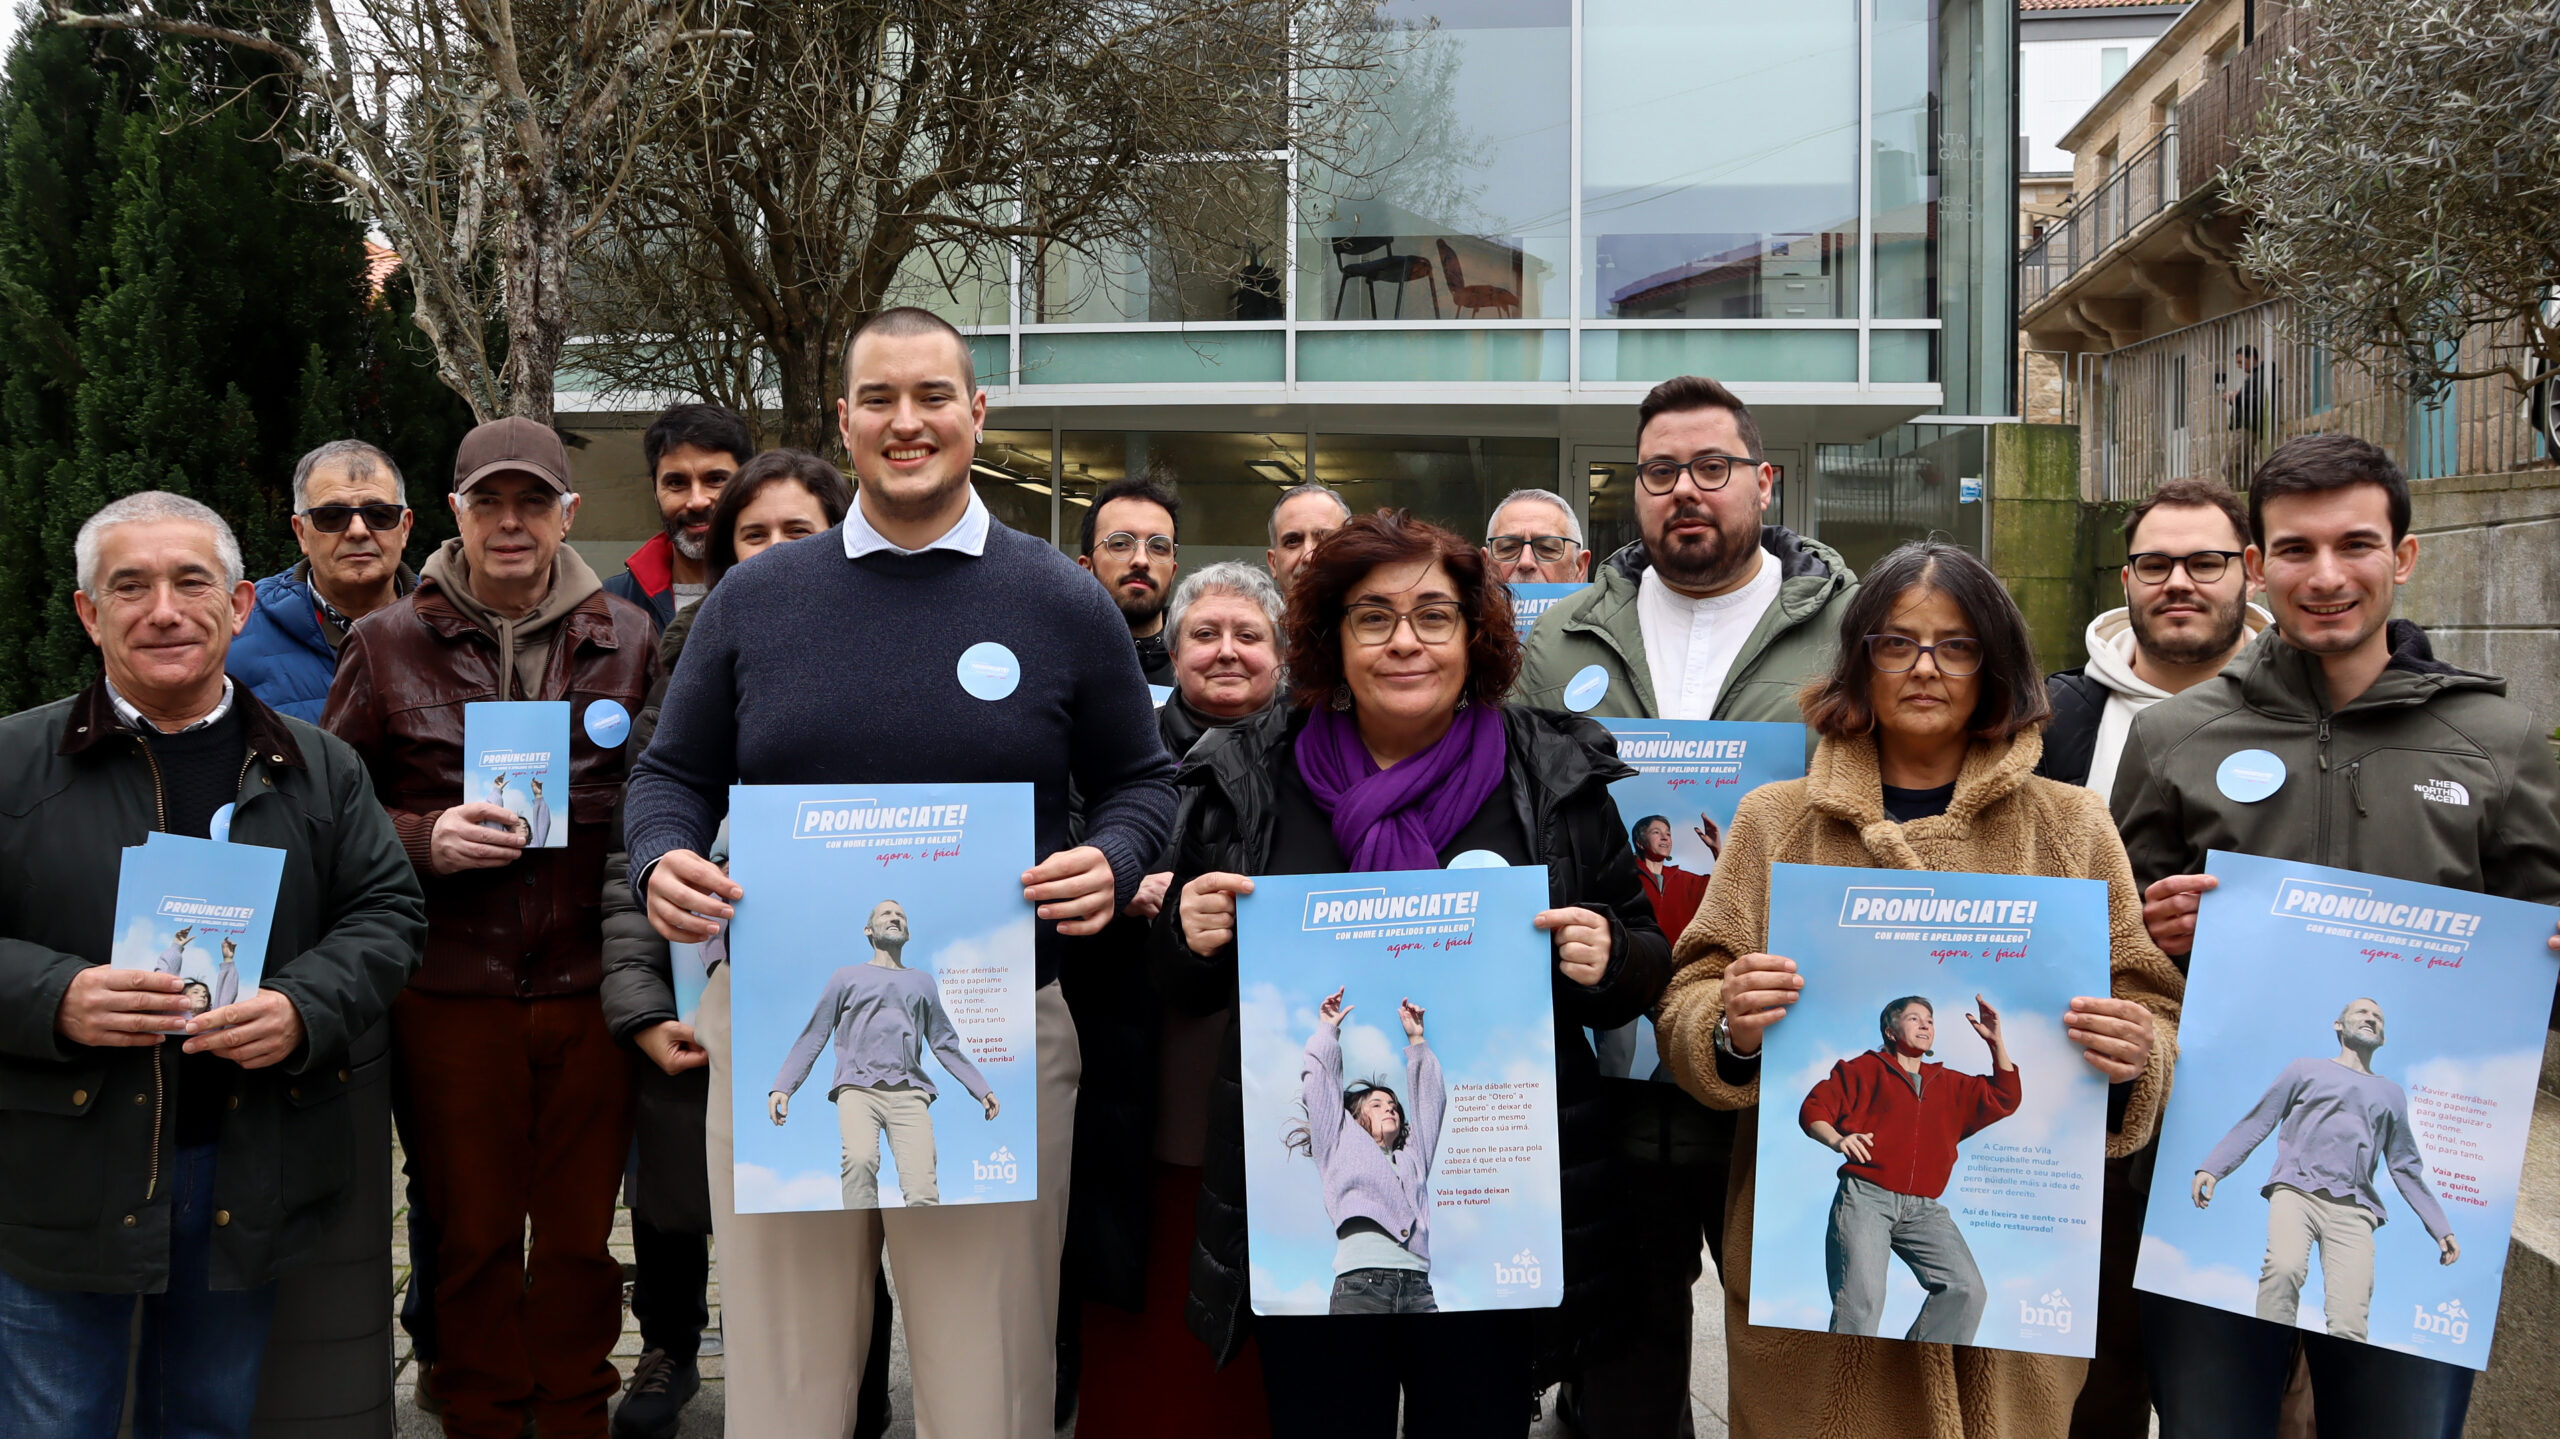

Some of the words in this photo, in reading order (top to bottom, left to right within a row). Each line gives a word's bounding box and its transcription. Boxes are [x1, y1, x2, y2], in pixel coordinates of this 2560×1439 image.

[483, 752, 551, 764] PRONUNCIATE!
[1715, 774, 1740, 788] fácil
[2429, 779, 2451, 788] THE
[2414, 784, 2450, 796] NORTH
[2424, 792, 2451, 803] FACE
[803, 804, 968, 832] PRONUNCIATE!
[868, 839, 873, 847] E
[875, 837, 913, 847] APELIDOS
[933, 844, 960, 861] fácil
[164, 901, 255, 918] PRONUNCIATE!
[1313, 891, 1479, 924] PRONUNCIATE!
[1851, 898, 2038, 924] PRONUNCIATE!
[2284, 889, 2482, 937] PRONUNCIATE!
[1336, 931, 1351, 941] CON
[1353, 930, 1376, 939] NOME
[1379, 929, 1384, 938] E
[1386, 927, 1423, 937] APELIDOS
[1426, 926, 1436, 934] EN
[1439, 924, 1468, 933] GALEGO
[1875, 932, 1892, 941] CON
[1894, 932, 1920, 941] NOME
[1922, 933, 1929, 941] E
[1931, 933, 1973, 942] APELIDOS
[1975, 934, 1987, 942] EN
[1990, 935, 2024, 943] GALEGO
[2306, 923, 2323, 933] CON
[2325, 927, 2351, 938] NOME
[2353, 930, 2360, 939] E
[2362, 932, 2407, 946] APELIDOS
[2409, 939, 2422, 948] EN
[2424, 941, 2461, 954] GALEGO
[1433, 939, 1440, 948] é
[1445, 933, 1473, 951] fácil
[1982, 947, 1990, 957] é
[1996, 945, 2028, 962] fácil
[2427, 956, 2464, 969] fácil
[967, 977, 1002, 985] papelame
[983, 1046, 1007, 1054] quitou
[2422, 1086, 2449, 1097] Xavier
[2414, 1096, 2434, 1106] todo
[2444, 1102, 2487, 1117] papelame
[1453, 1116, 1489, 1124] compartir
[2417, 1108, 2436, 1117] para
[2438, 1112, 2483, 1127] galeguizar
[1452, 1126, 1479, 1134] apelido
[1526, 1144, 1543, 1152] pola
[1993, 1144, 2020, 1152] Carme
[2460, 1139, 2477, 1148] non
[2438, 1147, 2458, 1156] para
[2032, 1158, 2059, 1166] mudar
[972, 1160, 1017, 1184] bng
[1968, 1165, 2024, 1175] publicamente
[2432, 1166, 2452, 1177] Vaia
[2454, 1172, 2476, 1181] peso
[1456, 1188, 1482, 1196] legado
[2050, 1182, 2067, 1190] idea
[2070, 1183, 2080, 1191] de
[2450, 1182, 2480, 1194] quitou
[2442, 1192, 2453, 1200] de
[2456, 1195, 2488, 1207] enriba!
[1992, 1209, 2017, 1218] lixeira
[2032, 1214, 2056, 1222] sente
[1970, 1220, 2001, 1228] apelido
[2003, 1224, 2053, 1233] restaurado!
[1493, 1262, 1541, 1288] bng
[2019, 1300, 2072, 1334] bng
[2414, 1304, 2469, 1344] bng
